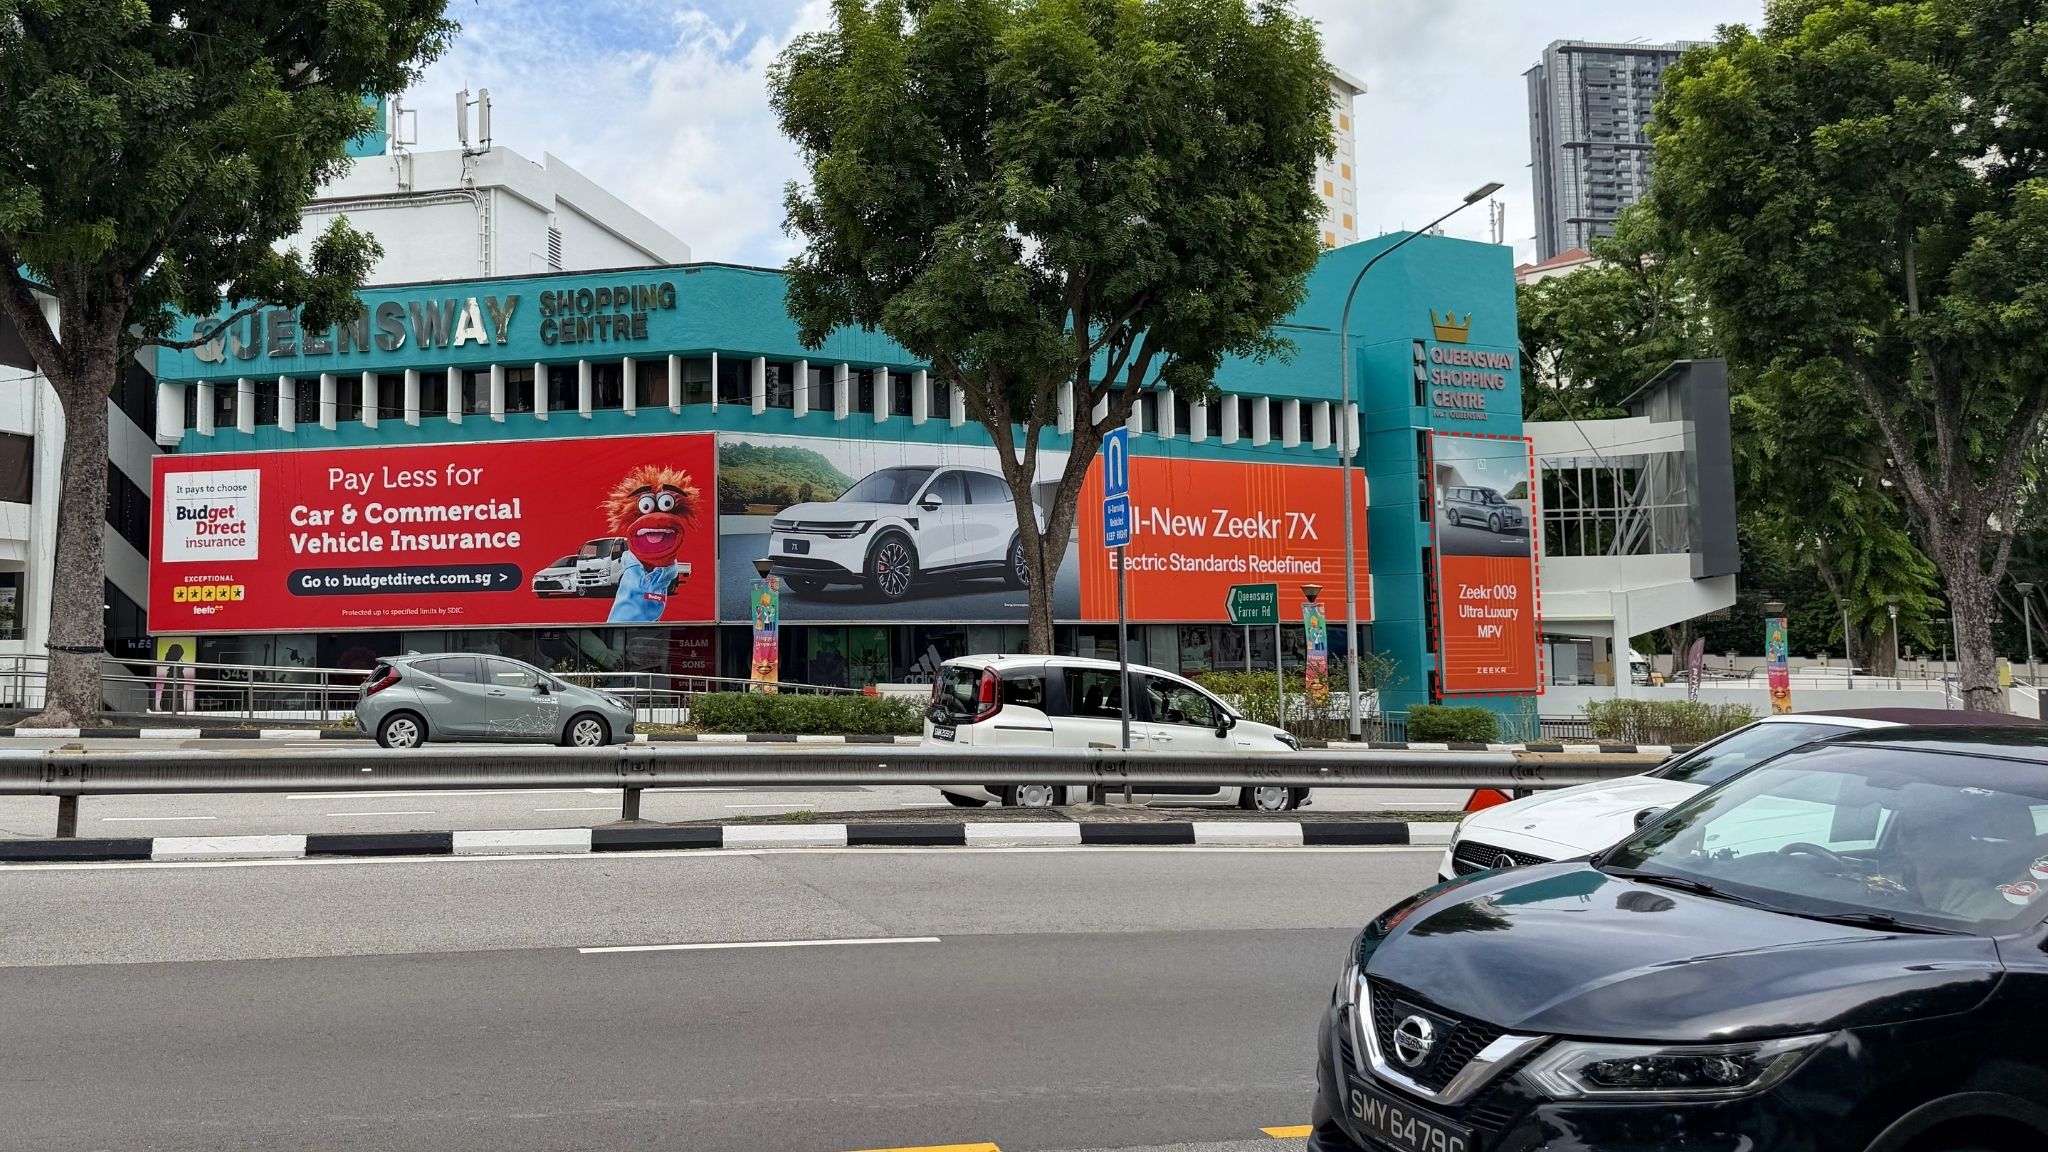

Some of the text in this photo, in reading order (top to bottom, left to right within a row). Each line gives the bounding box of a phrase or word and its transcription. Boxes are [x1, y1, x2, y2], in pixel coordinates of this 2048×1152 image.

[539, 282, 677, 317] SHOPPING
[540, 313, 649, 346] CENTRE
[1430, 347, 1515, 370] QUEENSWAY
[1431, 368, 1505, 390] SHOPPING
[1433, 390, 1486, 410] CENTRE
[328, 463, 484, 496] Pay Less for
[176, 484, 248, 496] It pays to choose
[176, 505, 235, 523] Budget
[290, 498, 522, 527] Car & Commercial
[196, 520, 247, 536] Direct
[1129, 506, 1319, 540] ll-New Zeekr 7X
[185, 537, 246, 549] insurance
[290, 530, 521, 554] Vehicle Insurance
[1106, 531, 1116, 541] KEEP
[1109, 551, 1321, 574] Eectric Standards Redefined
[184, 575, 234, 583] EXCEPTIONAL
[301, 571, 492, 588] Go to budgetdirect.com.sg
[1237, 590, 1274, 603] Queensway
[1459, 584, 1517, 599] Zeekr 009
[391, 607, 419, 615] specified
[1238, 605, 1271, 617] Farrer Rd
[1459, 604, 1518, 620] Ultra Luxury
[1477, 625, 1502, 638] MPV
[679, 639, 709, 648] SALAM
[690, 649, 698, 658] &
[682, 660, 706, 669] SONS
